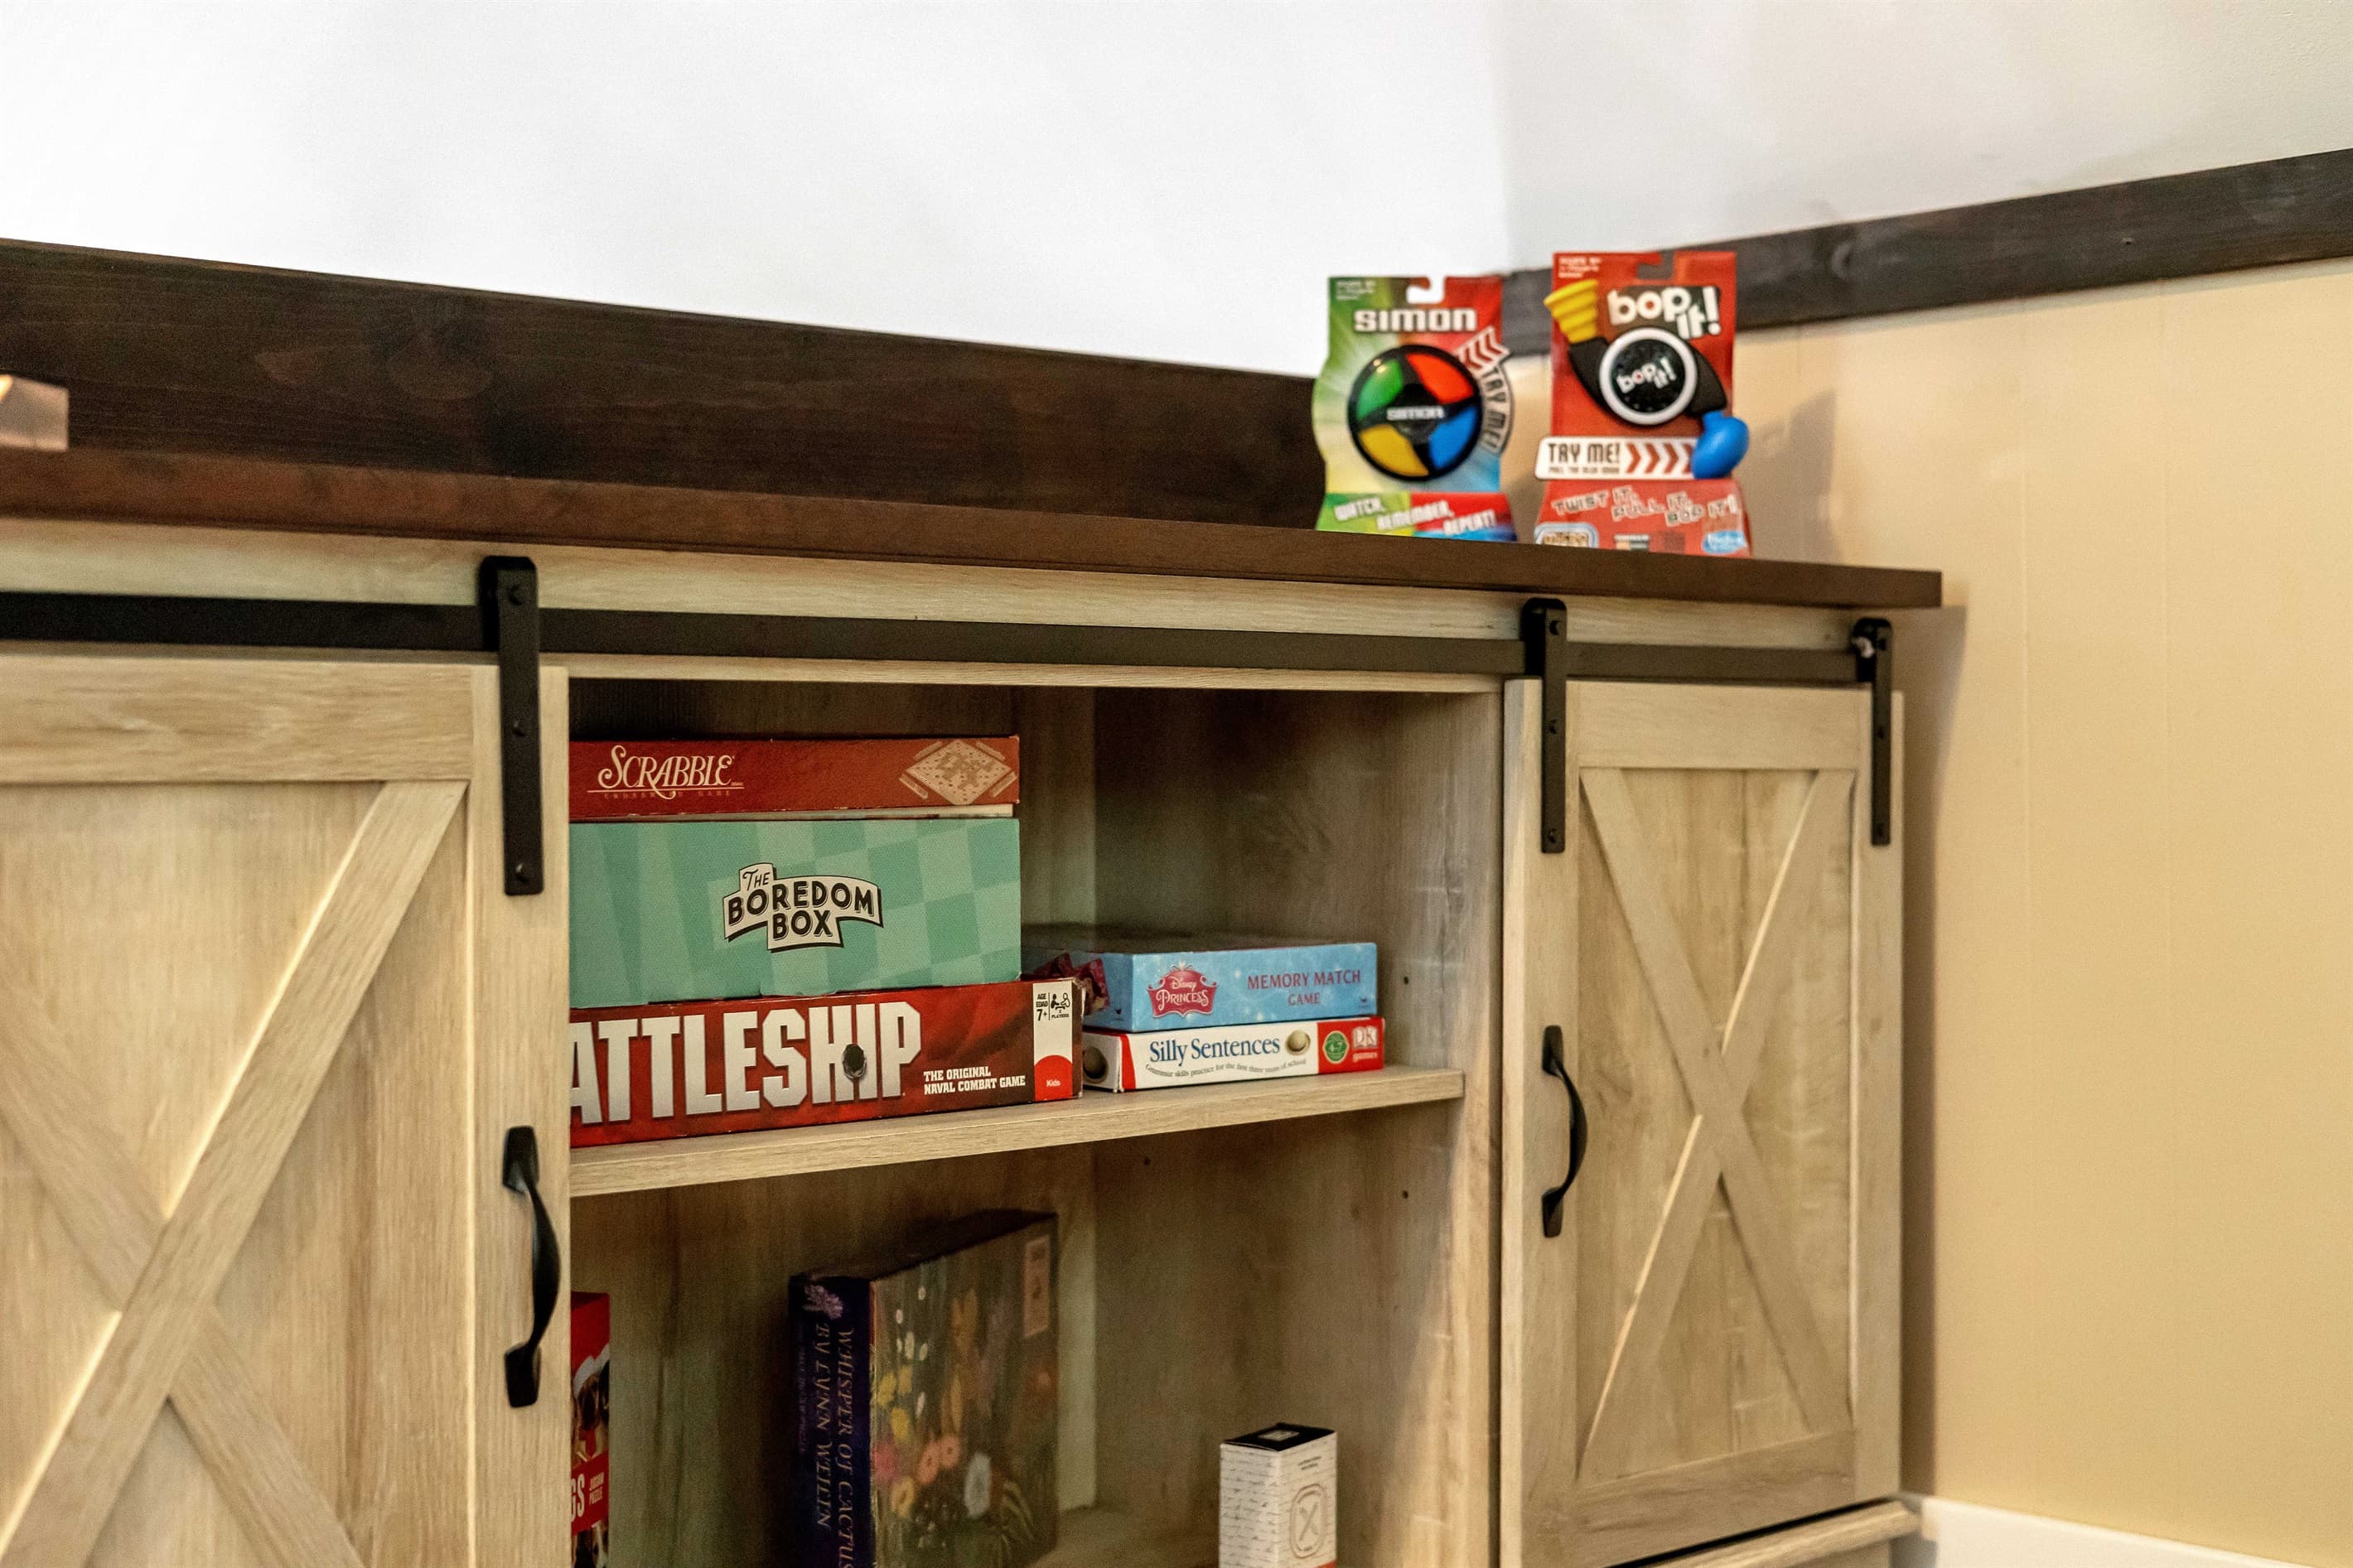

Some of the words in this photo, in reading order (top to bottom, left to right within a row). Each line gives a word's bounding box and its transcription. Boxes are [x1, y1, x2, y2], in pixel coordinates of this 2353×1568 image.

[1607, 287, 1692, 326] bop
[1481, 365, 1506, 403] TRY
[1481, 410, 1506, 449] ME!
[1548, 443, 1580, 463] TRY
[1587, 443, 1621, 464] ME!
[1551, 490, 1610, 515] TWIST
[598, 745, 732, 799] SCRABBLE
[742, 869, 771, 891] THE
[727, 880, 874, 926] BOREDOM
[772, 909, 833, 940] BOX
[1247, 973, 1309, 990] MEMORY
[1313, 969, 1361, 987] MATCH
[1288, 991, 1321, 1006] GAME
[1036, 1009, 1047, 1020] 7+
[1149, 1040, 1188, 1067] Silly
[1191, 1038, 1280, 1059] Sentences
[923, 1070, 944, 1082] THE
[946, 1066, 992, 1080] ORIGINAL
[924, 1081, 956, 1095] NAVAL
[958, 1078, 998, 1092] COMBAT
[999, 1075, 1027, 1088] GAME
[1046, 1079, 1061, 1088] Kids
[814, 1323, 830, 1353] BY
[814, 1359, 831, 1430] LYNN
[837, 1326, 854, 1435] WHISPER
[835, 1444, 853, 1475] OF
